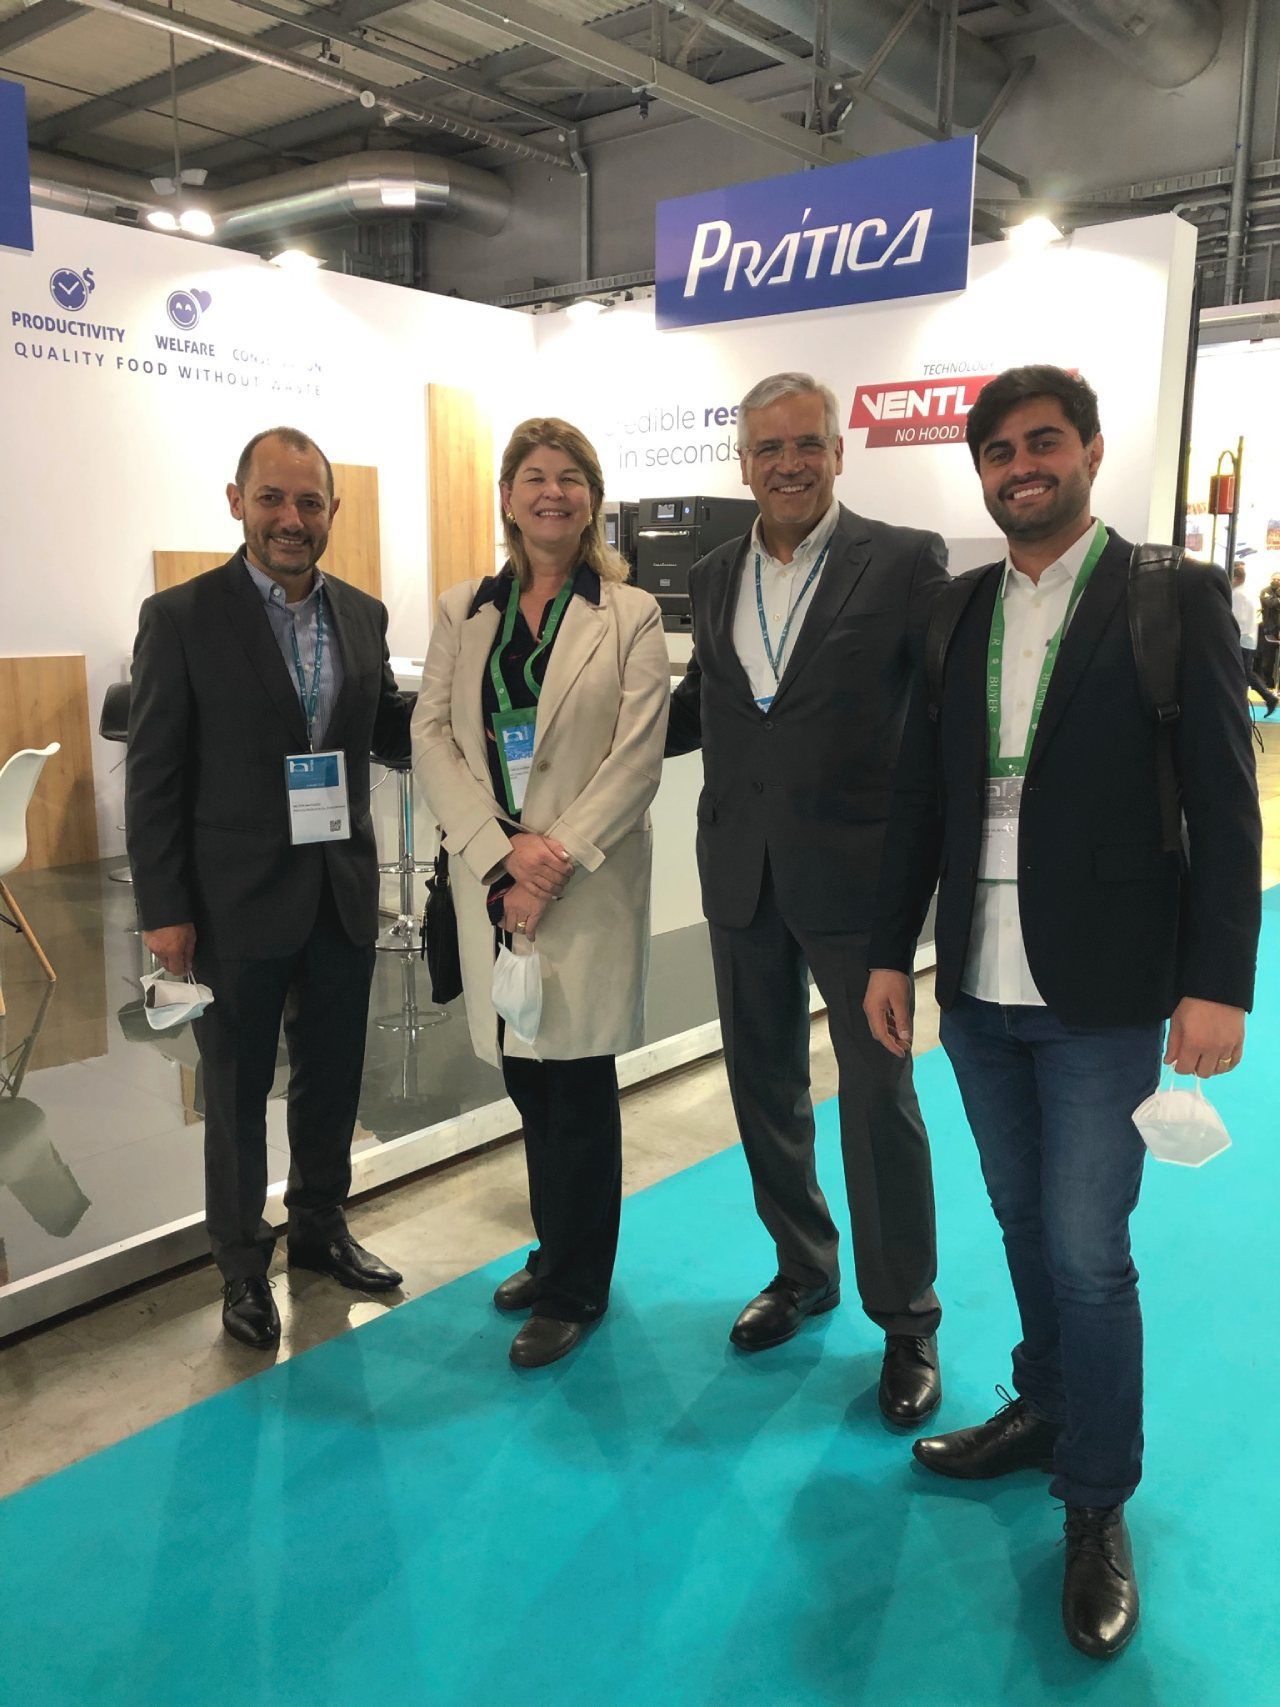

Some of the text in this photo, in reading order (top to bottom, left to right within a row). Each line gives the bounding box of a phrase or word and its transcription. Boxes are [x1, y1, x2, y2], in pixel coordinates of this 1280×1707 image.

[683, 208, 933, 298] PRÁTICA
[11, 311, 126, 343] PRODUCTIVITY
[155, 335, 215, 357] WELFARE
[14, 341, 105, 367] QUALITY
[116, 356, 168, 376] FOOD
[178, 365, 259, 387] WITHOUT
[923, 360, 995, 376] TECHNOLO
[704, 404, 741, 428] res
[861, 385, 974, 421] VENTL
[894, 428, 916, 443] NO
[918, 425, 960, 441] HOOD
[619, 445, 638, 469] in
[988, 676, 999, 713] BUYER
